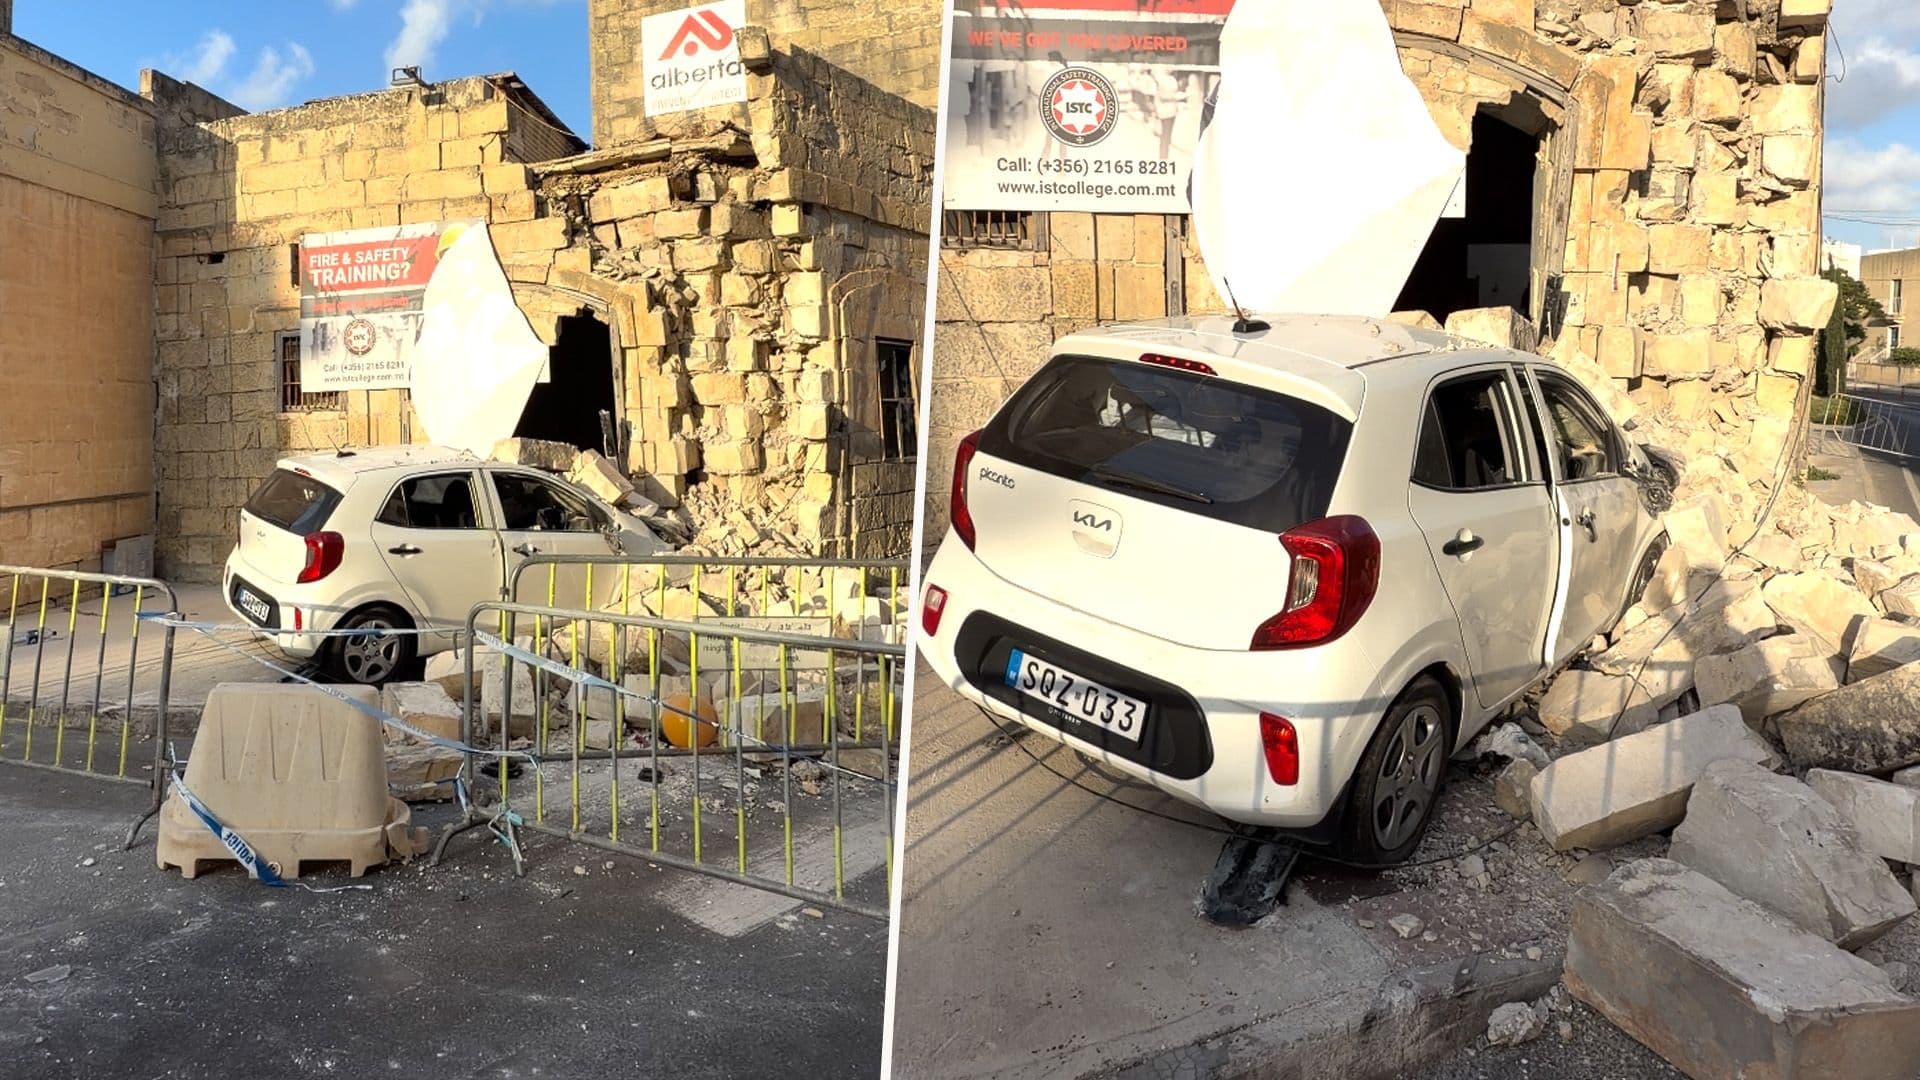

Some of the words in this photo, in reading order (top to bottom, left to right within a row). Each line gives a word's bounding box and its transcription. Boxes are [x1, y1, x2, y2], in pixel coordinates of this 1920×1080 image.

[1025, 31, 1061, 49] GOT
[1067, 33, 1102, 50] YOU
[1107, 34, 1188, 53] COVERED
[651, 58, 742, 90] alberta
[1066, 102, 1092, 113] ISTC
[997, 157, 1032, 173] Call:
[1037, 159, 1089, 177] (+356)
[1094, 160, 1133, 174] 2165
[1138, 161, 1176, 175] 8281
[998, 181, 1176, 198] www.istcollege.com.mt
[309, 253, 338, 268] FIRE
[342, 252, 351, 265] &
[355, 247, 410, 264] SAFETY
[309, 262, 412, 287] TRAINING?
[979, 467, 1016, 489] picanto
[1073, 509, 1112, 532] KIA
[223, 831, 255, 865] POLICE
